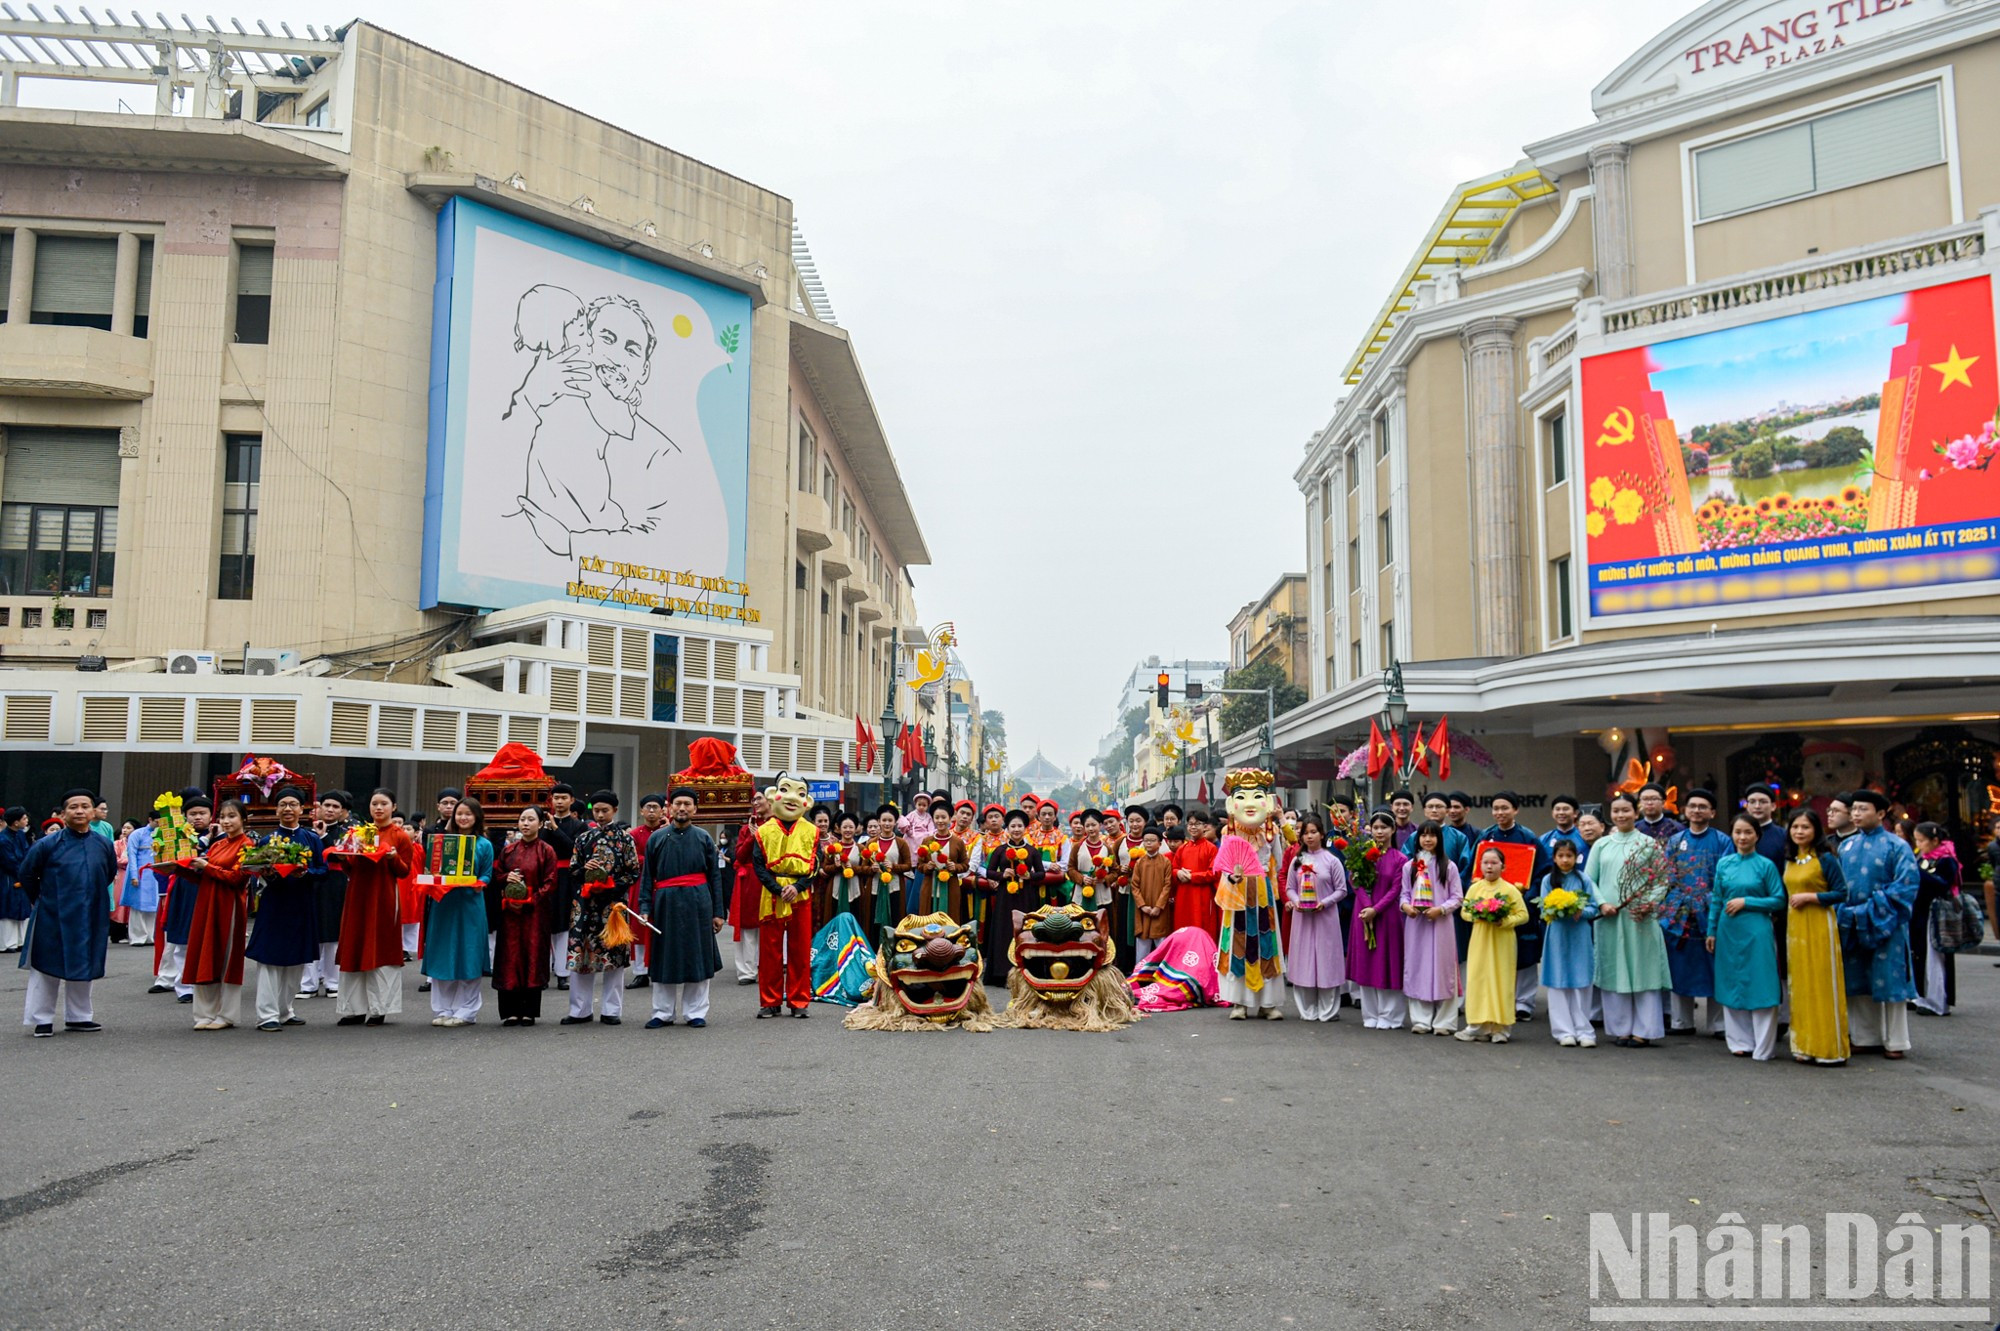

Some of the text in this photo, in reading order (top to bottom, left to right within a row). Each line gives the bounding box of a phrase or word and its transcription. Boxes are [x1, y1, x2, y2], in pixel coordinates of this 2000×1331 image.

[1686, 0, 1913, 74] TRANG TIE
[1765, 34, 1846, 70] PLAZA
[1598, 565, 1627, 582] MỪNG
[1628, 562, 1647, 579] ĐẤT
[1648, 559, 1675, 577] NƯỚC
[1695, 554, 1718, 572] MỚI,
[1720, 552, 1751, 569] MỪNG
[1752, 546, 1782, 566] ĐẢNG
[1783, 545, 1820, 564] QUANG
[1821, 542, 1852, 558] VINH,
[1853, 536, 1888, 555] MỪNG
[1889, 532, 1922, 551] XUÂN
[1924, 528, 1939, 547] ẤT
[1941, 530, 1956, 547] TỴ
[1957, 526, 1988, 544] 2025
[652, 568, 671, 586] LẠI
[676, 569, 697, 587] ĐẤT
[739, 582, 750, 597] TA
